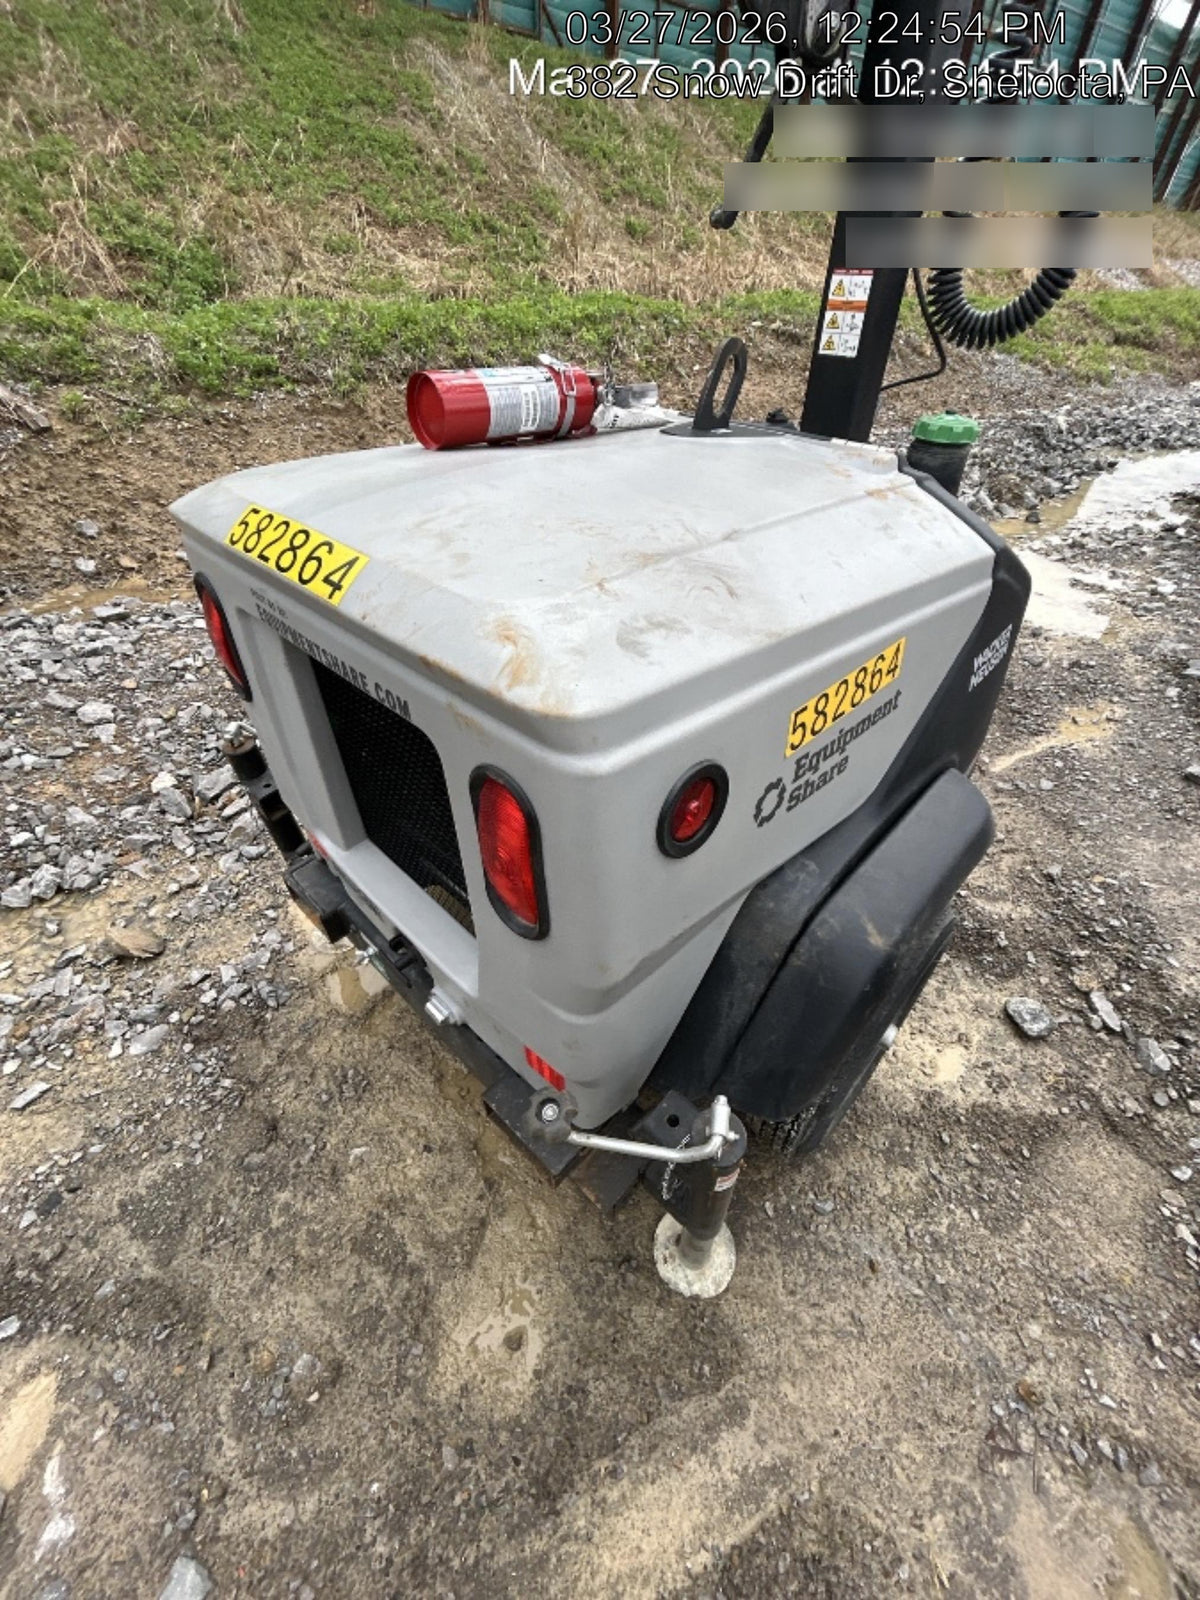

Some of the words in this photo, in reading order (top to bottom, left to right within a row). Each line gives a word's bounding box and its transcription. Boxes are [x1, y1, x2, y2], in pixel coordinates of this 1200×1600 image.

[230, 508, 360, 599] 582864
[790, 643, 902, 751] 582864
[792, 689, 902, 784] Equipment
[786, 755, 849, 812] Share
